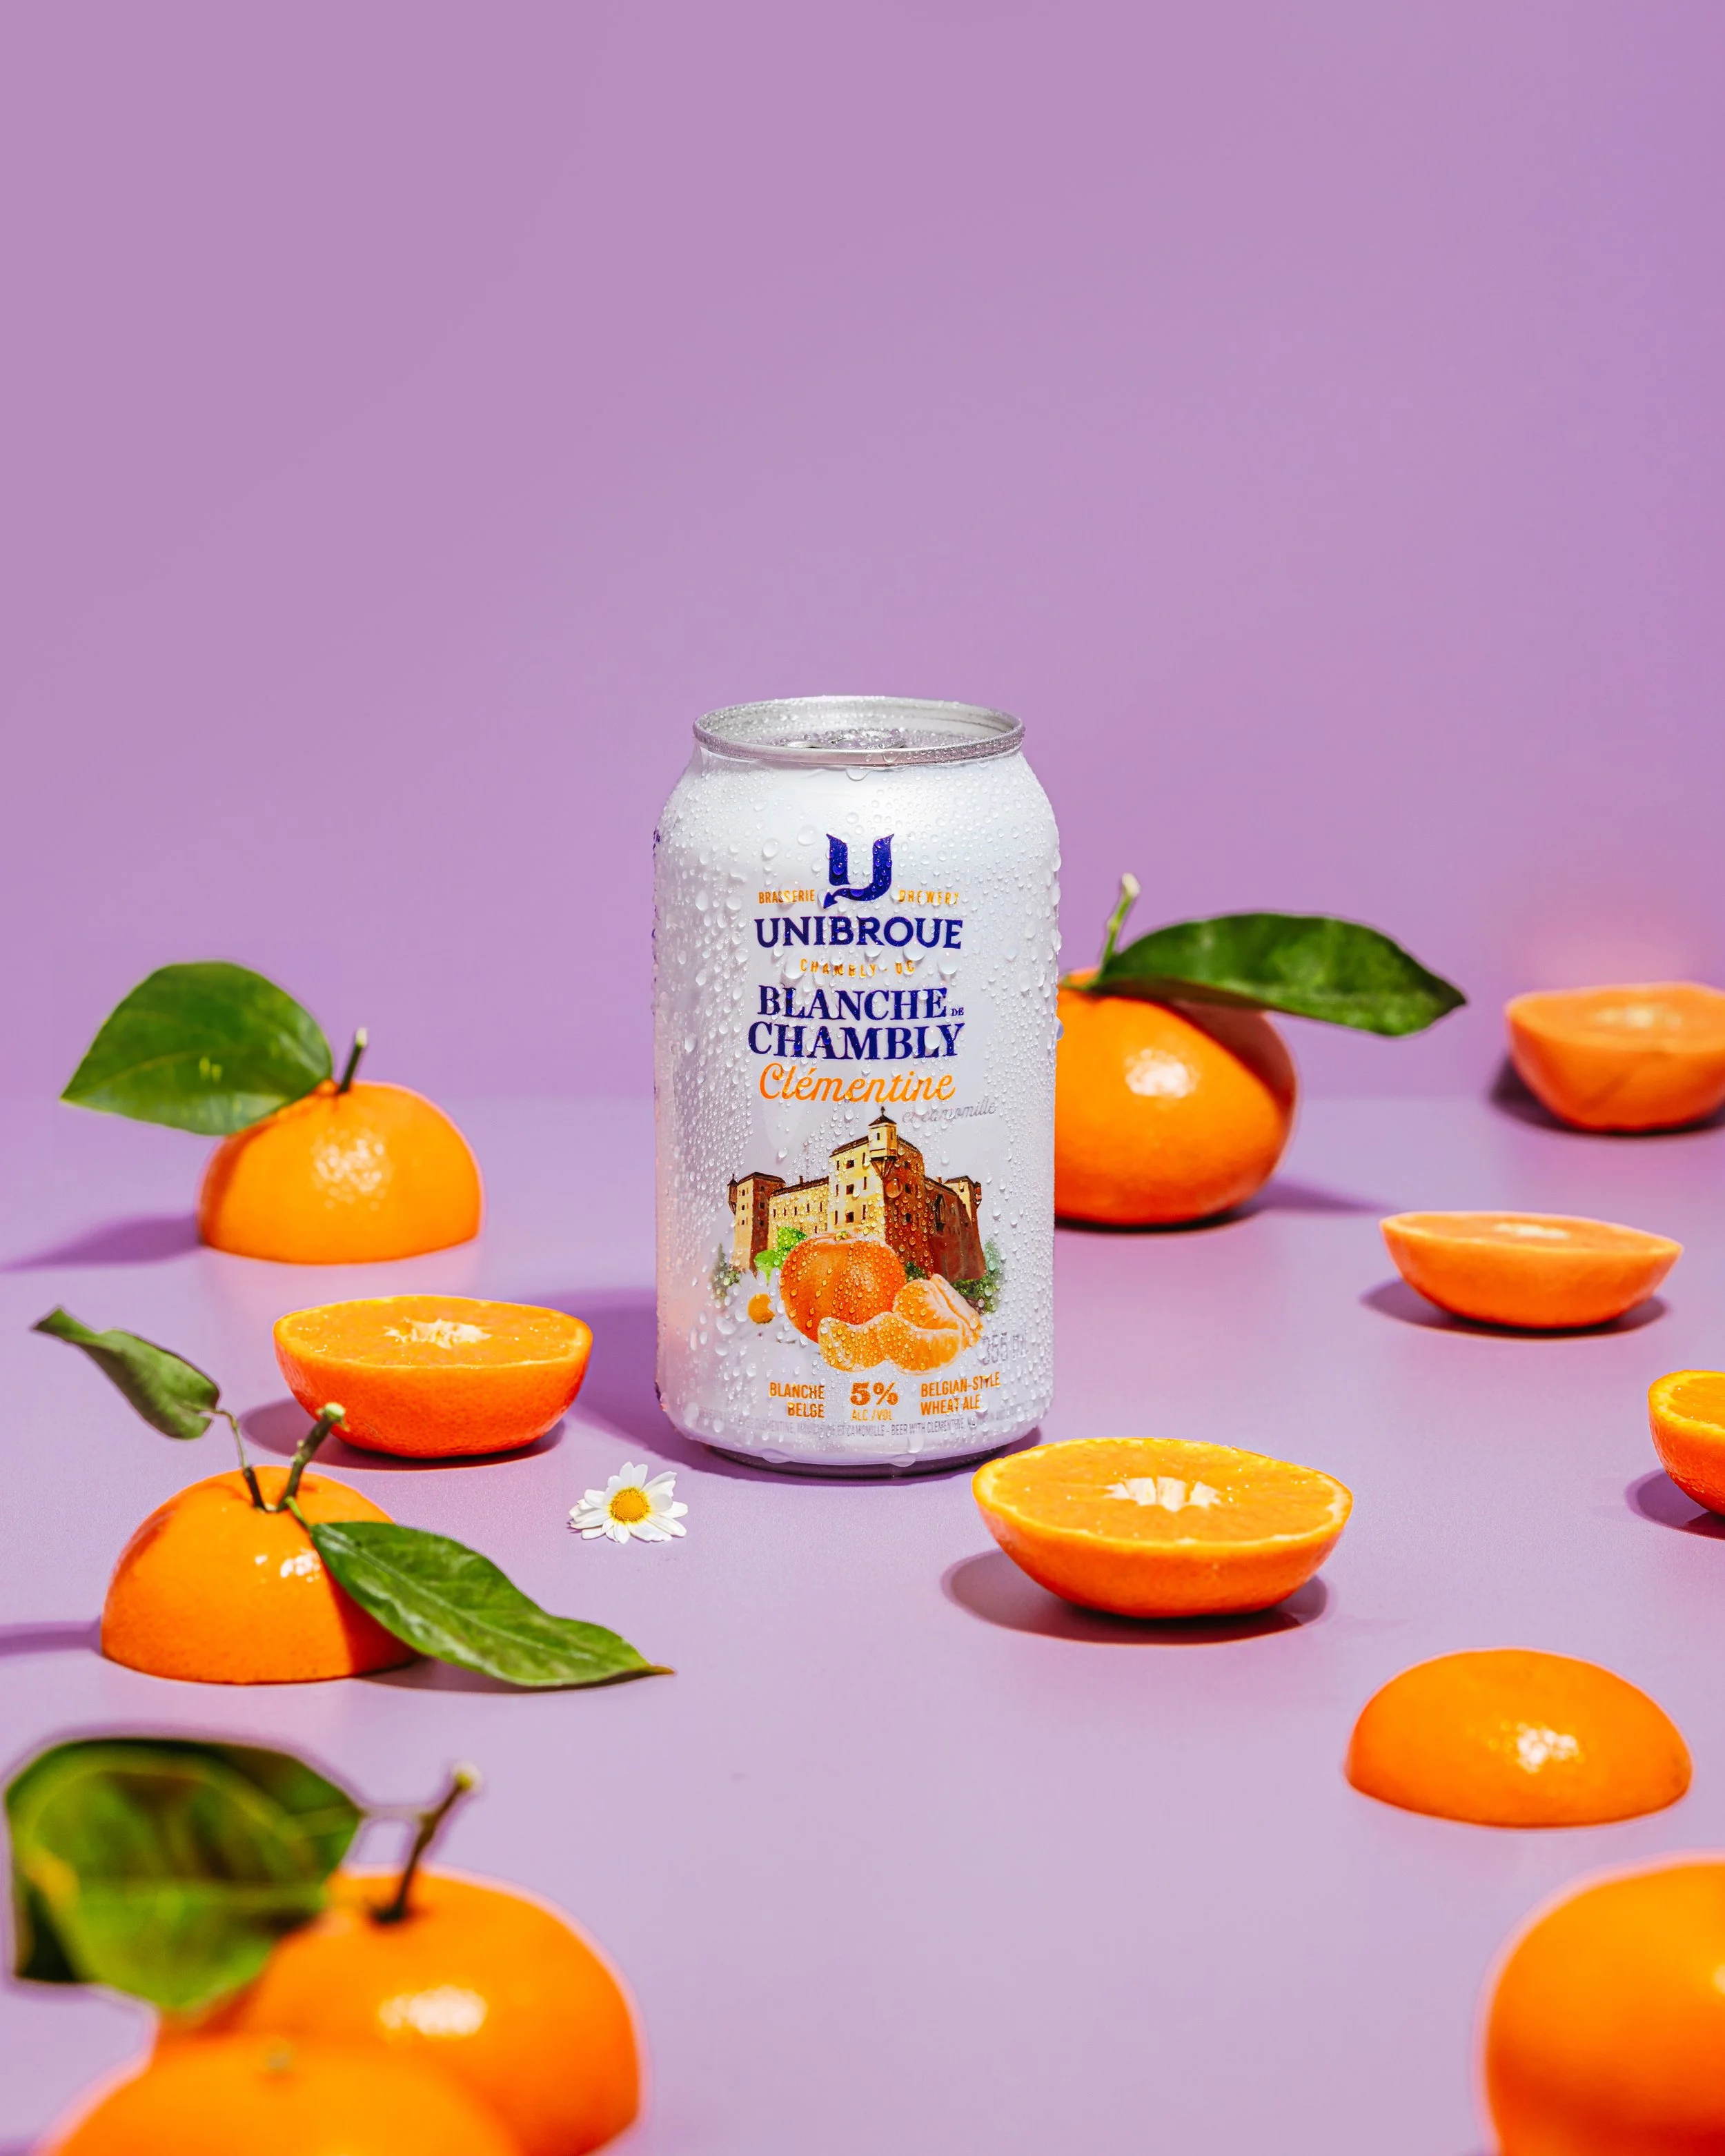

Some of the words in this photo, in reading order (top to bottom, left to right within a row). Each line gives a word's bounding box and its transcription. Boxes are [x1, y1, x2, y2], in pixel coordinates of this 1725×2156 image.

[758, 889, 816, 904] BRASSERIE
[754, 916, 964, 950] UNIBROUE
[757, 985, 948, 1022] BLANCHE
[951, 1007, 965, 1017] DE
[747, 1020, 965, 1060] CHAMBLY
[758, 1062, 956, 1104] Clémentine
[769, 1382, 825, 1400] BLANCHE
[849, 1381, 899, 1406] 5%
[920, 1372, 1000, 1398] BELGIAN-STYLE
[787, 1401, 825, 1418] BELGE
[920, 1398, 960, 1416] WHEAT
[963, 1394, 981, 1410] ALE
[891, 1423, 908, 1436] BEER
[909, 1422, 926, 1434] WITH
